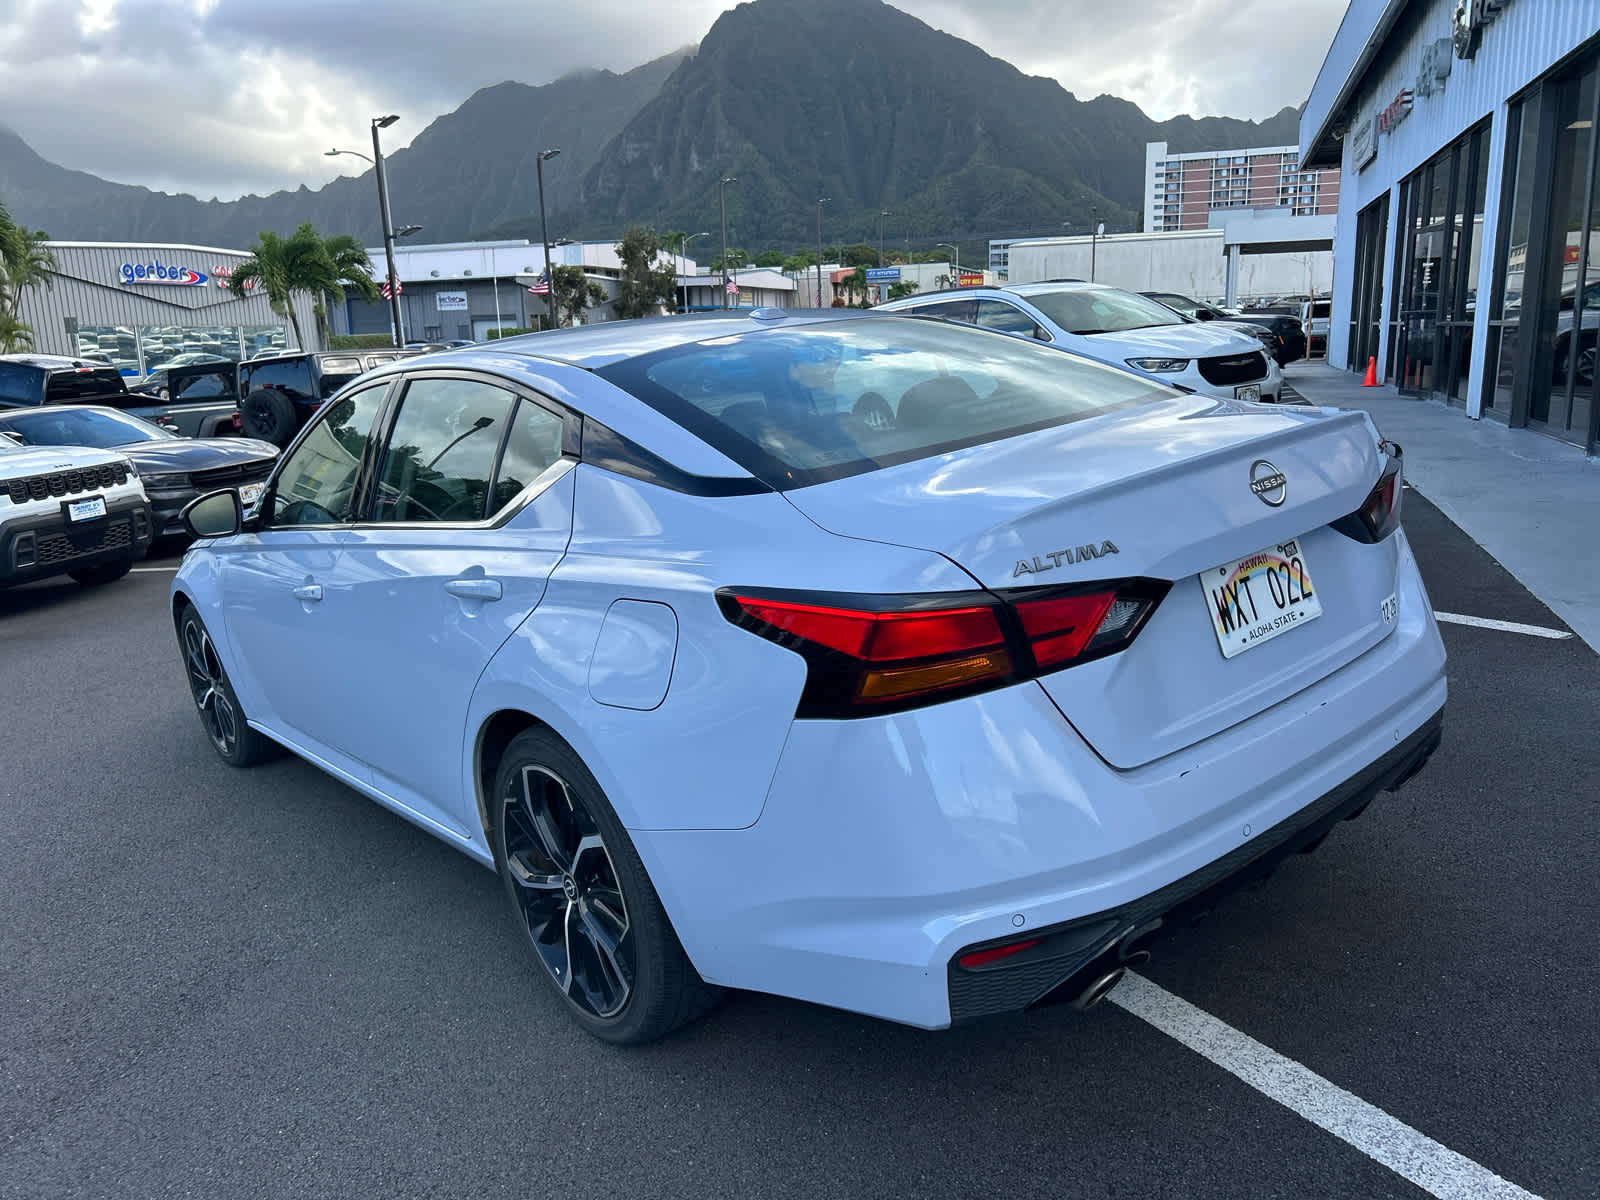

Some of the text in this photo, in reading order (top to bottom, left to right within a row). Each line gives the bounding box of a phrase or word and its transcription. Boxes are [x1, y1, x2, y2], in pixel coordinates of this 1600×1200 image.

[122, 260, 187, 284] gerber
[1013, 540, 1120, 577] ALTIMA
[1238, 553, 1268, 573] HAWAII
[1212, 557, 1313, 634] WXT 022
[1249, 611, 1297, 640] ALOHA STATE
